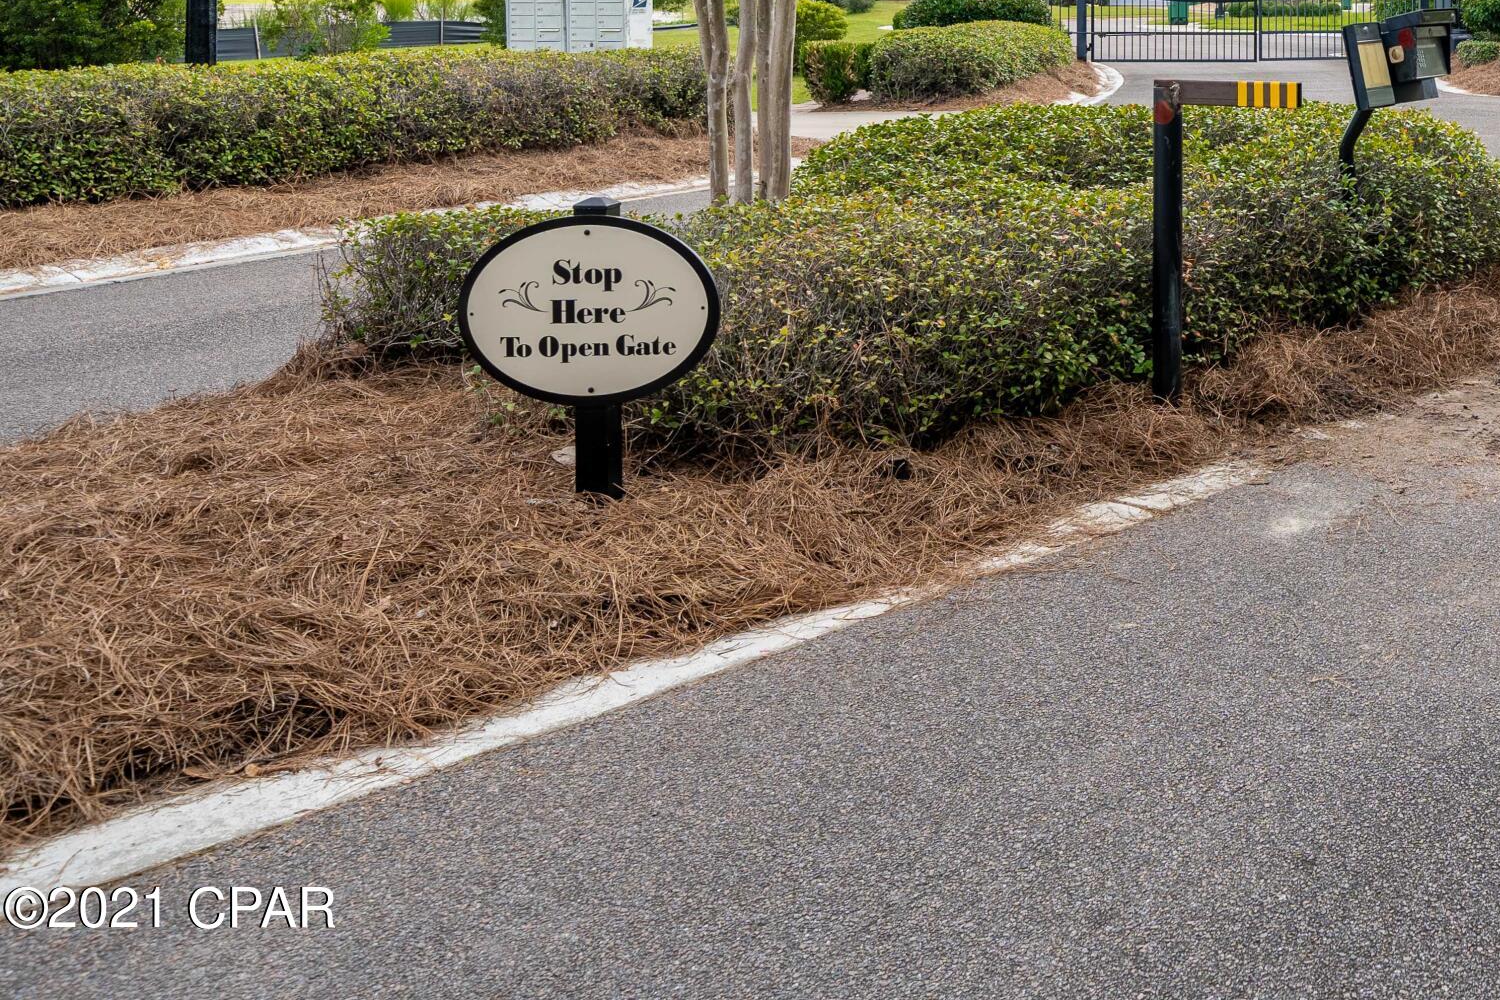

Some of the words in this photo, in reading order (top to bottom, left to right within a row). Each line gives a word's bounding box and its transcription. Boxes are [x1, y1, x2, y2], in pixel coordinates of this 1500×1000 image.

[552, 259, 622, 292] Stop
[549, 299, 626, 325] Here
[500, 336, 532, 358] To
[538, 335, 610, 364] Open
[615, 334, 677, 357] Gate
